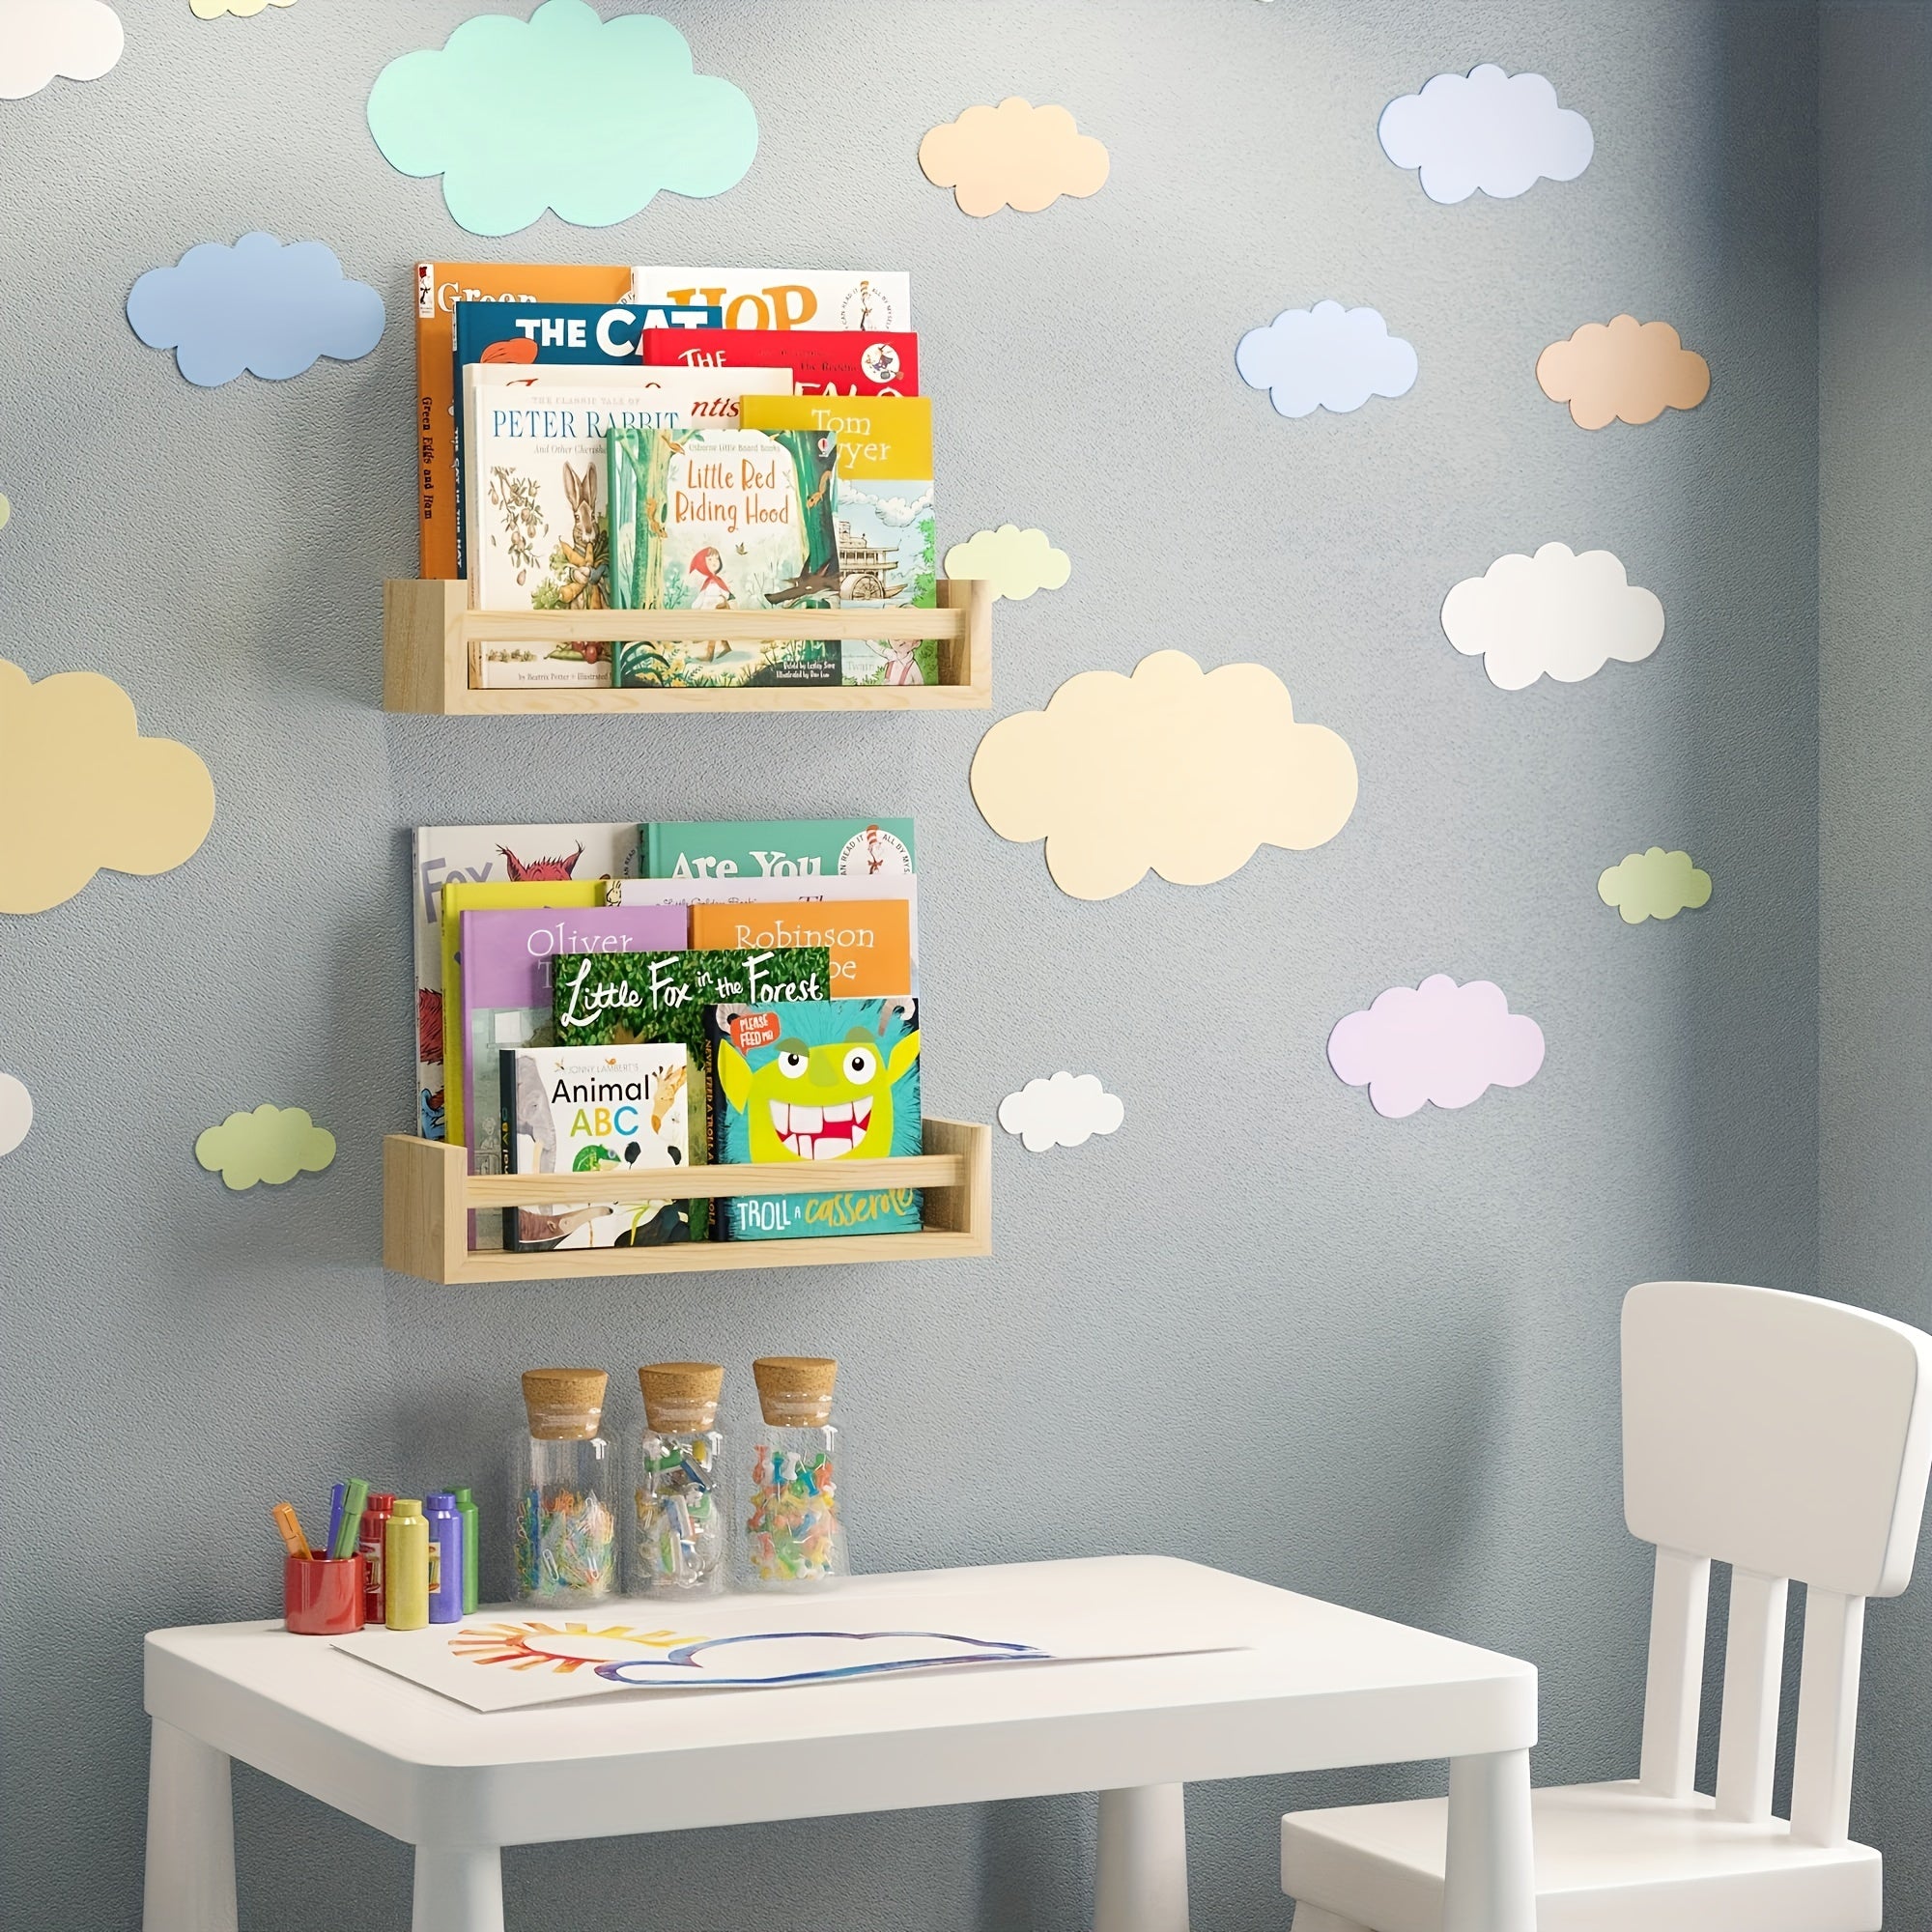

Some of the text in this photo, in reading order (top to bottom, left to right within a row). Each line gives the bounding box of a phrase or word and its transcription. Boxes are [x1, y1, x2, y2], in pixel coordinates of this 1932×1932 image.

[515, 318, 587, 348] THE
[691, 398, 740, 417] ntis
[811, 409, 871, 436] Tom
[493, 410, 681, 439] PETER RABBIT
[422, 397, 434, 519] Green Eggs and Ham
[534, 444, 607, 455] And Other Cherishe
[688, 459, 775, 490] Little Red
[676, 490, 789, 533] Riding Hood
[841, 841, 856, 862] READ
[857, 835, 864, 843] IT
[882, 834, 895, 845] ALL
[671, 851, 822, 879] Are You
[527, 922, 633, 956] Oliver
[735, 920, 875, 950] Robinson
[561, 958, 643, 1027] Little
[647, 956, 693, 1011] Fox
[696, 971, 714, 989] in
[715, 977, 744, 999] the
[742, 952, 824, 1003] Forest
[739, 1014, 768, 1032] PLEASE
[740, 1031, 762, 1048] FEED
[552, 1074, 650, 1104] Animal
[570, 1106, 639, 1137] ABC
[737, 1200, 792, 1231] TROLL
[794, 1206, 801, 1219] A
